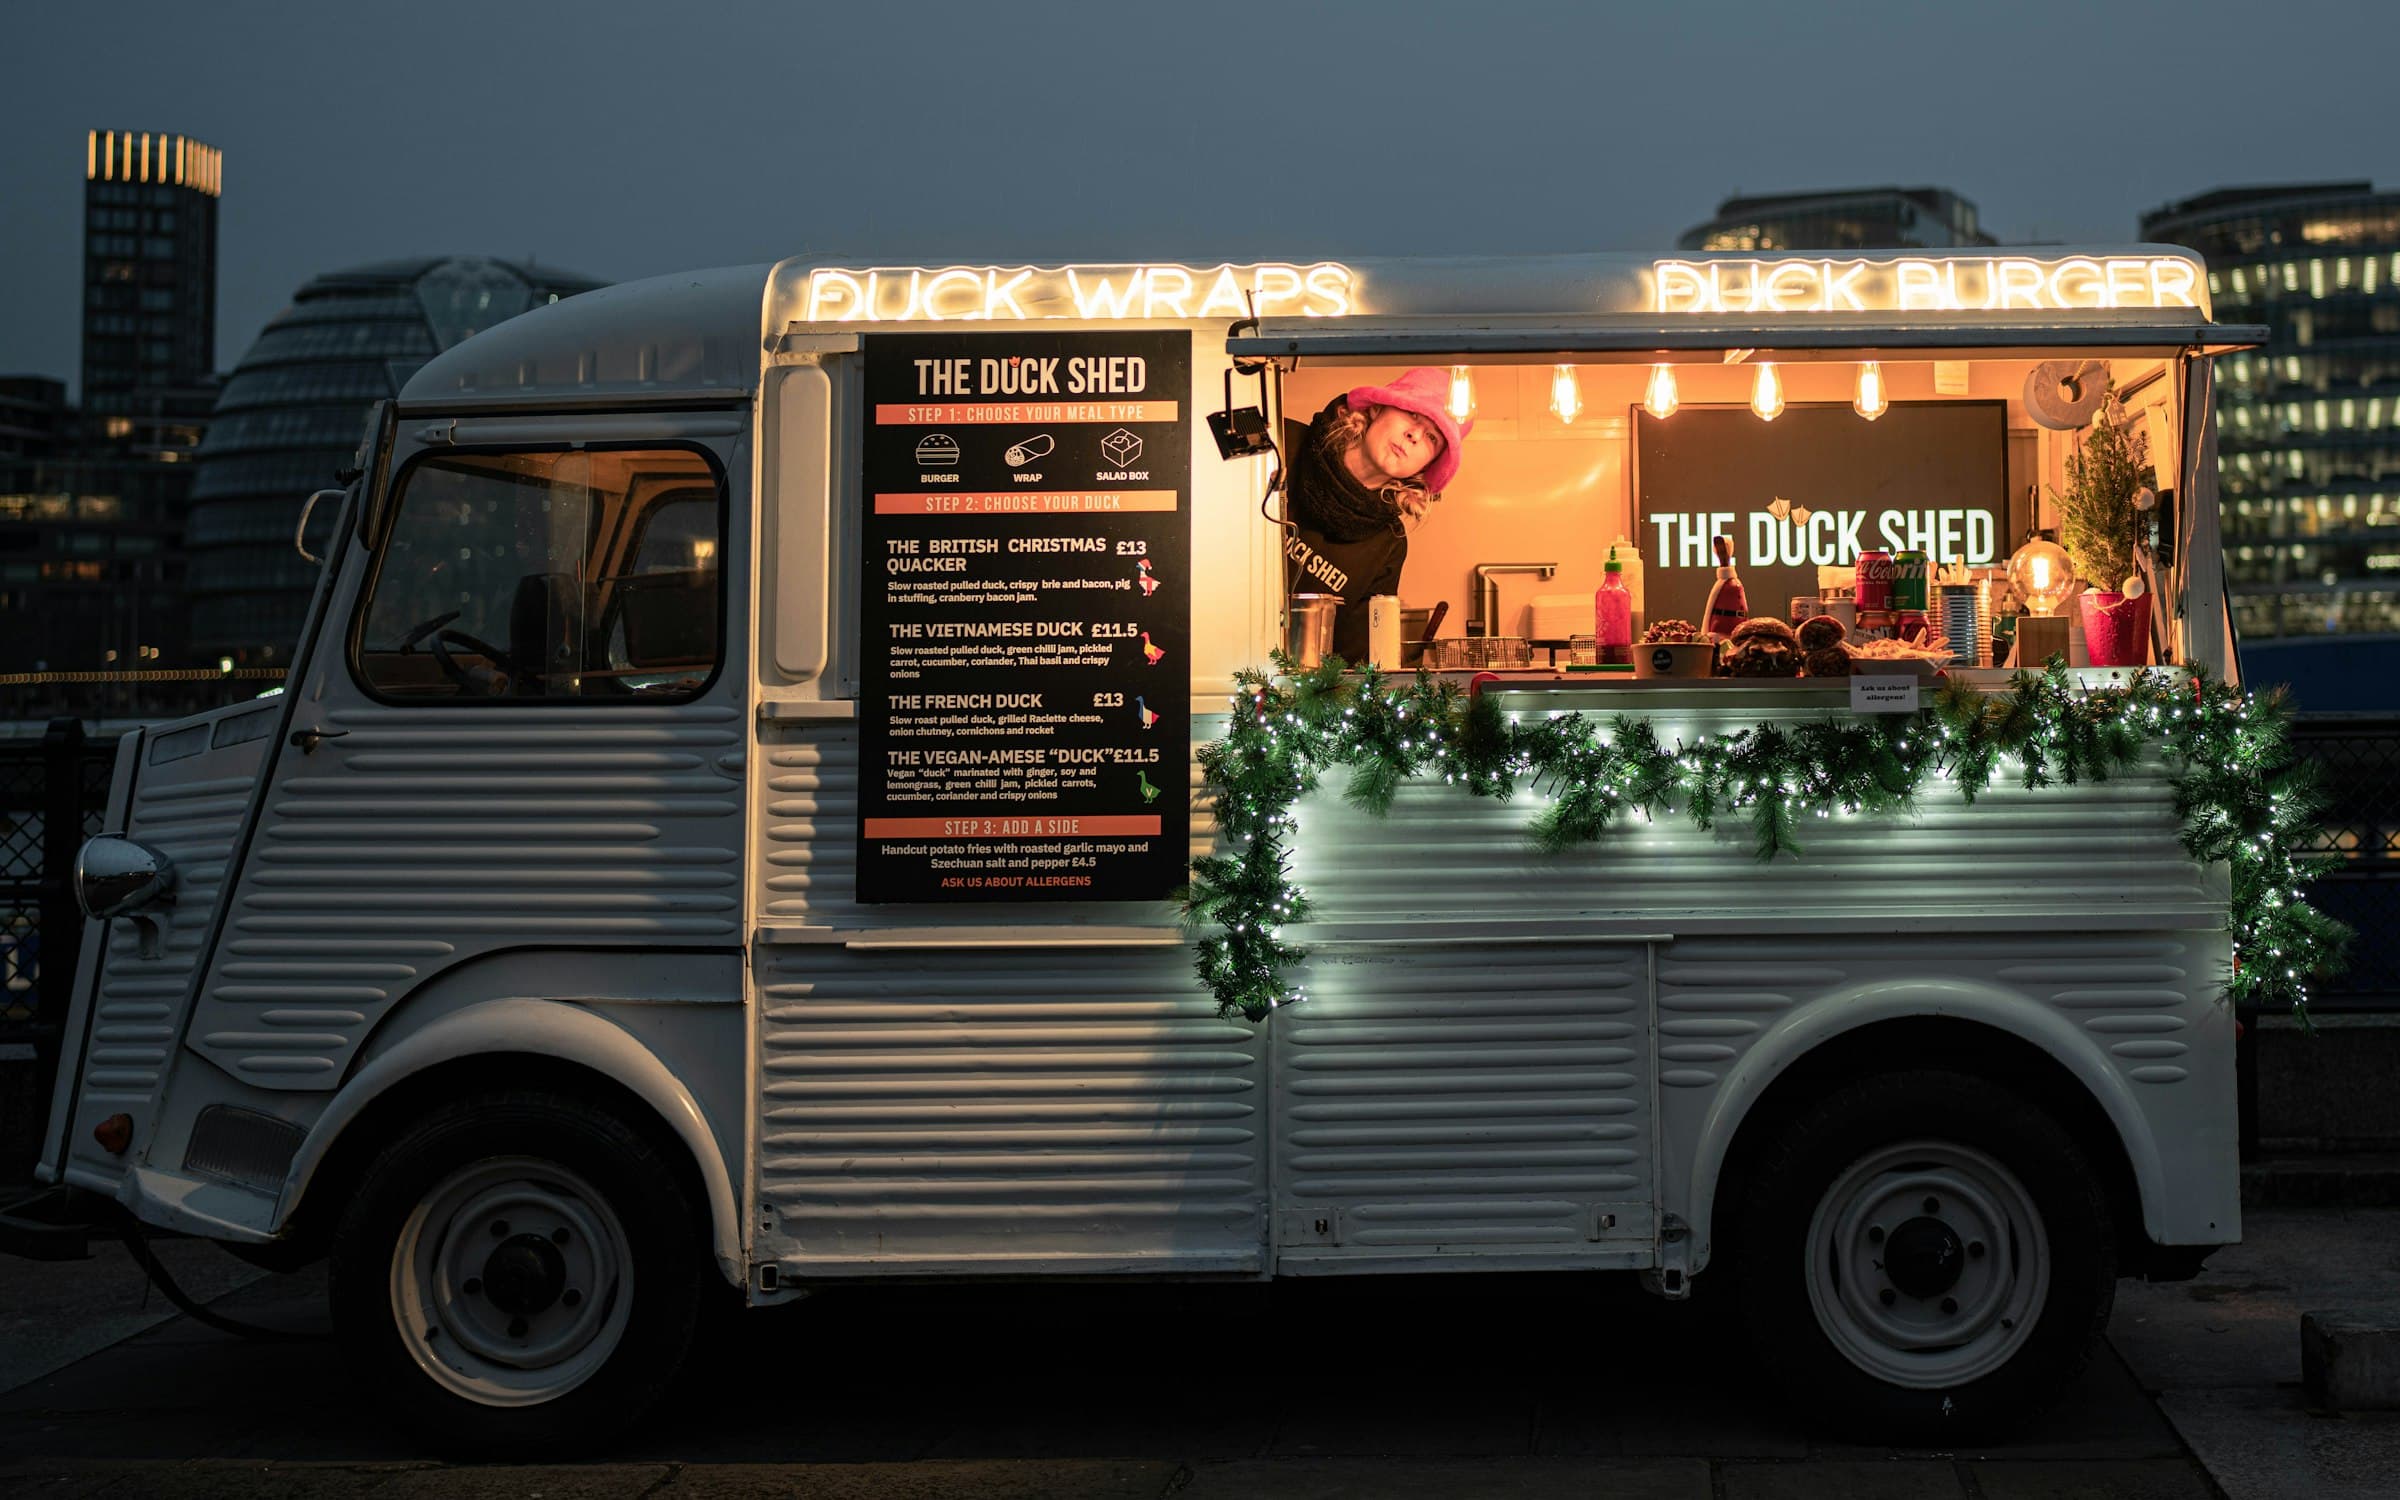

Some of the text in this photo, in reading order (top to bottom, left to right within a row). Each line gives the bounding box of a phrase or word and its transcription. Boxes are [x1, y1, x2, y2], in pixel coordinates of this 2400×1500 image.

[1656, 258, 2196, 312] DUCK BURGER
[807, 266, 1350, 320] DUCK WRAPS
[914, 356, 1146, 396] THE DUCK SHED
[907, 405, 1144, 423] STEP 1: CHOOSE YOUR MEAL TYPE
[920, 474, 960, 484] BURGER
[1013, 473, 1043, 483] WRAP
[1095, 470, 1150, 481] SALAD BOX
[925, 494, 1121, 513] STEP 2: CHOOSE YOUR DUCK
[1650, 508, 1996, 568] THE DUCK SHED
[886, 537, 1147, 556] THE BRITISH CHRISTMAS £13
[886, 558, 967, 576] QUACKER
[1306, 553, 1349, 593] SHED
[887, 577, 1132, 592] Slow roasted pulled duck, crispy brie and bacon, pig
[887, 593, 897, 603] in
[938, 592, 986, 604] cranberry
[986, 592, 1016, 602] bacon
[1015, 590, 1038, 603] jam.
[889, 621, 1138, 638] THE VIETNAMESE DUCK £11.5
[890, 643, 1113, 658] Slow roasted pulled duck, green chilli jam, pickled
[889, 655, 1110, 669] carrot, cucumber, coriander, Thai basil and crispy
[889, 669, 921, 679] onions
[888, 692, 1124, 710] THE FRENCH DUCK £13
[889, 713, 1104, 726] Slow roast pulled duck, grilled Raclette cheese,
[889, 725, 1055, 737] onion chutney, cornichons and rocket
[887, 751, 921, 765] THE
[923, 749, 1046, 765] VEGAN-AMESE
[1113, 748, 1160, 764] £11.5
[887, 769, 916, 780] Vegan
[953, 767, 1000, 777] marinated
[1002, 767, 1024, 777] with
[1026, 766, 1058, 778] ginger,
[1060, 768, 1077, 778] soy
[1078, 766, 1097, 776] and
[886, 778, 1097, 792] lemongrass, green chilli jam, pickled carrots,
[886, 789, 1058, 802] cucumber, coriander and crispy onions
[944, 819, 1079, 836] STEP 3: ADD A SIDE
[881, 841, 1149, 857] Handcut potato fries with roasted garlic mayo and
[930, 856, 1097, 870] Szechuan salt and pepper £4.5
[941, 876, 1092, 888] ASK US ABOUT ALLERGENS
